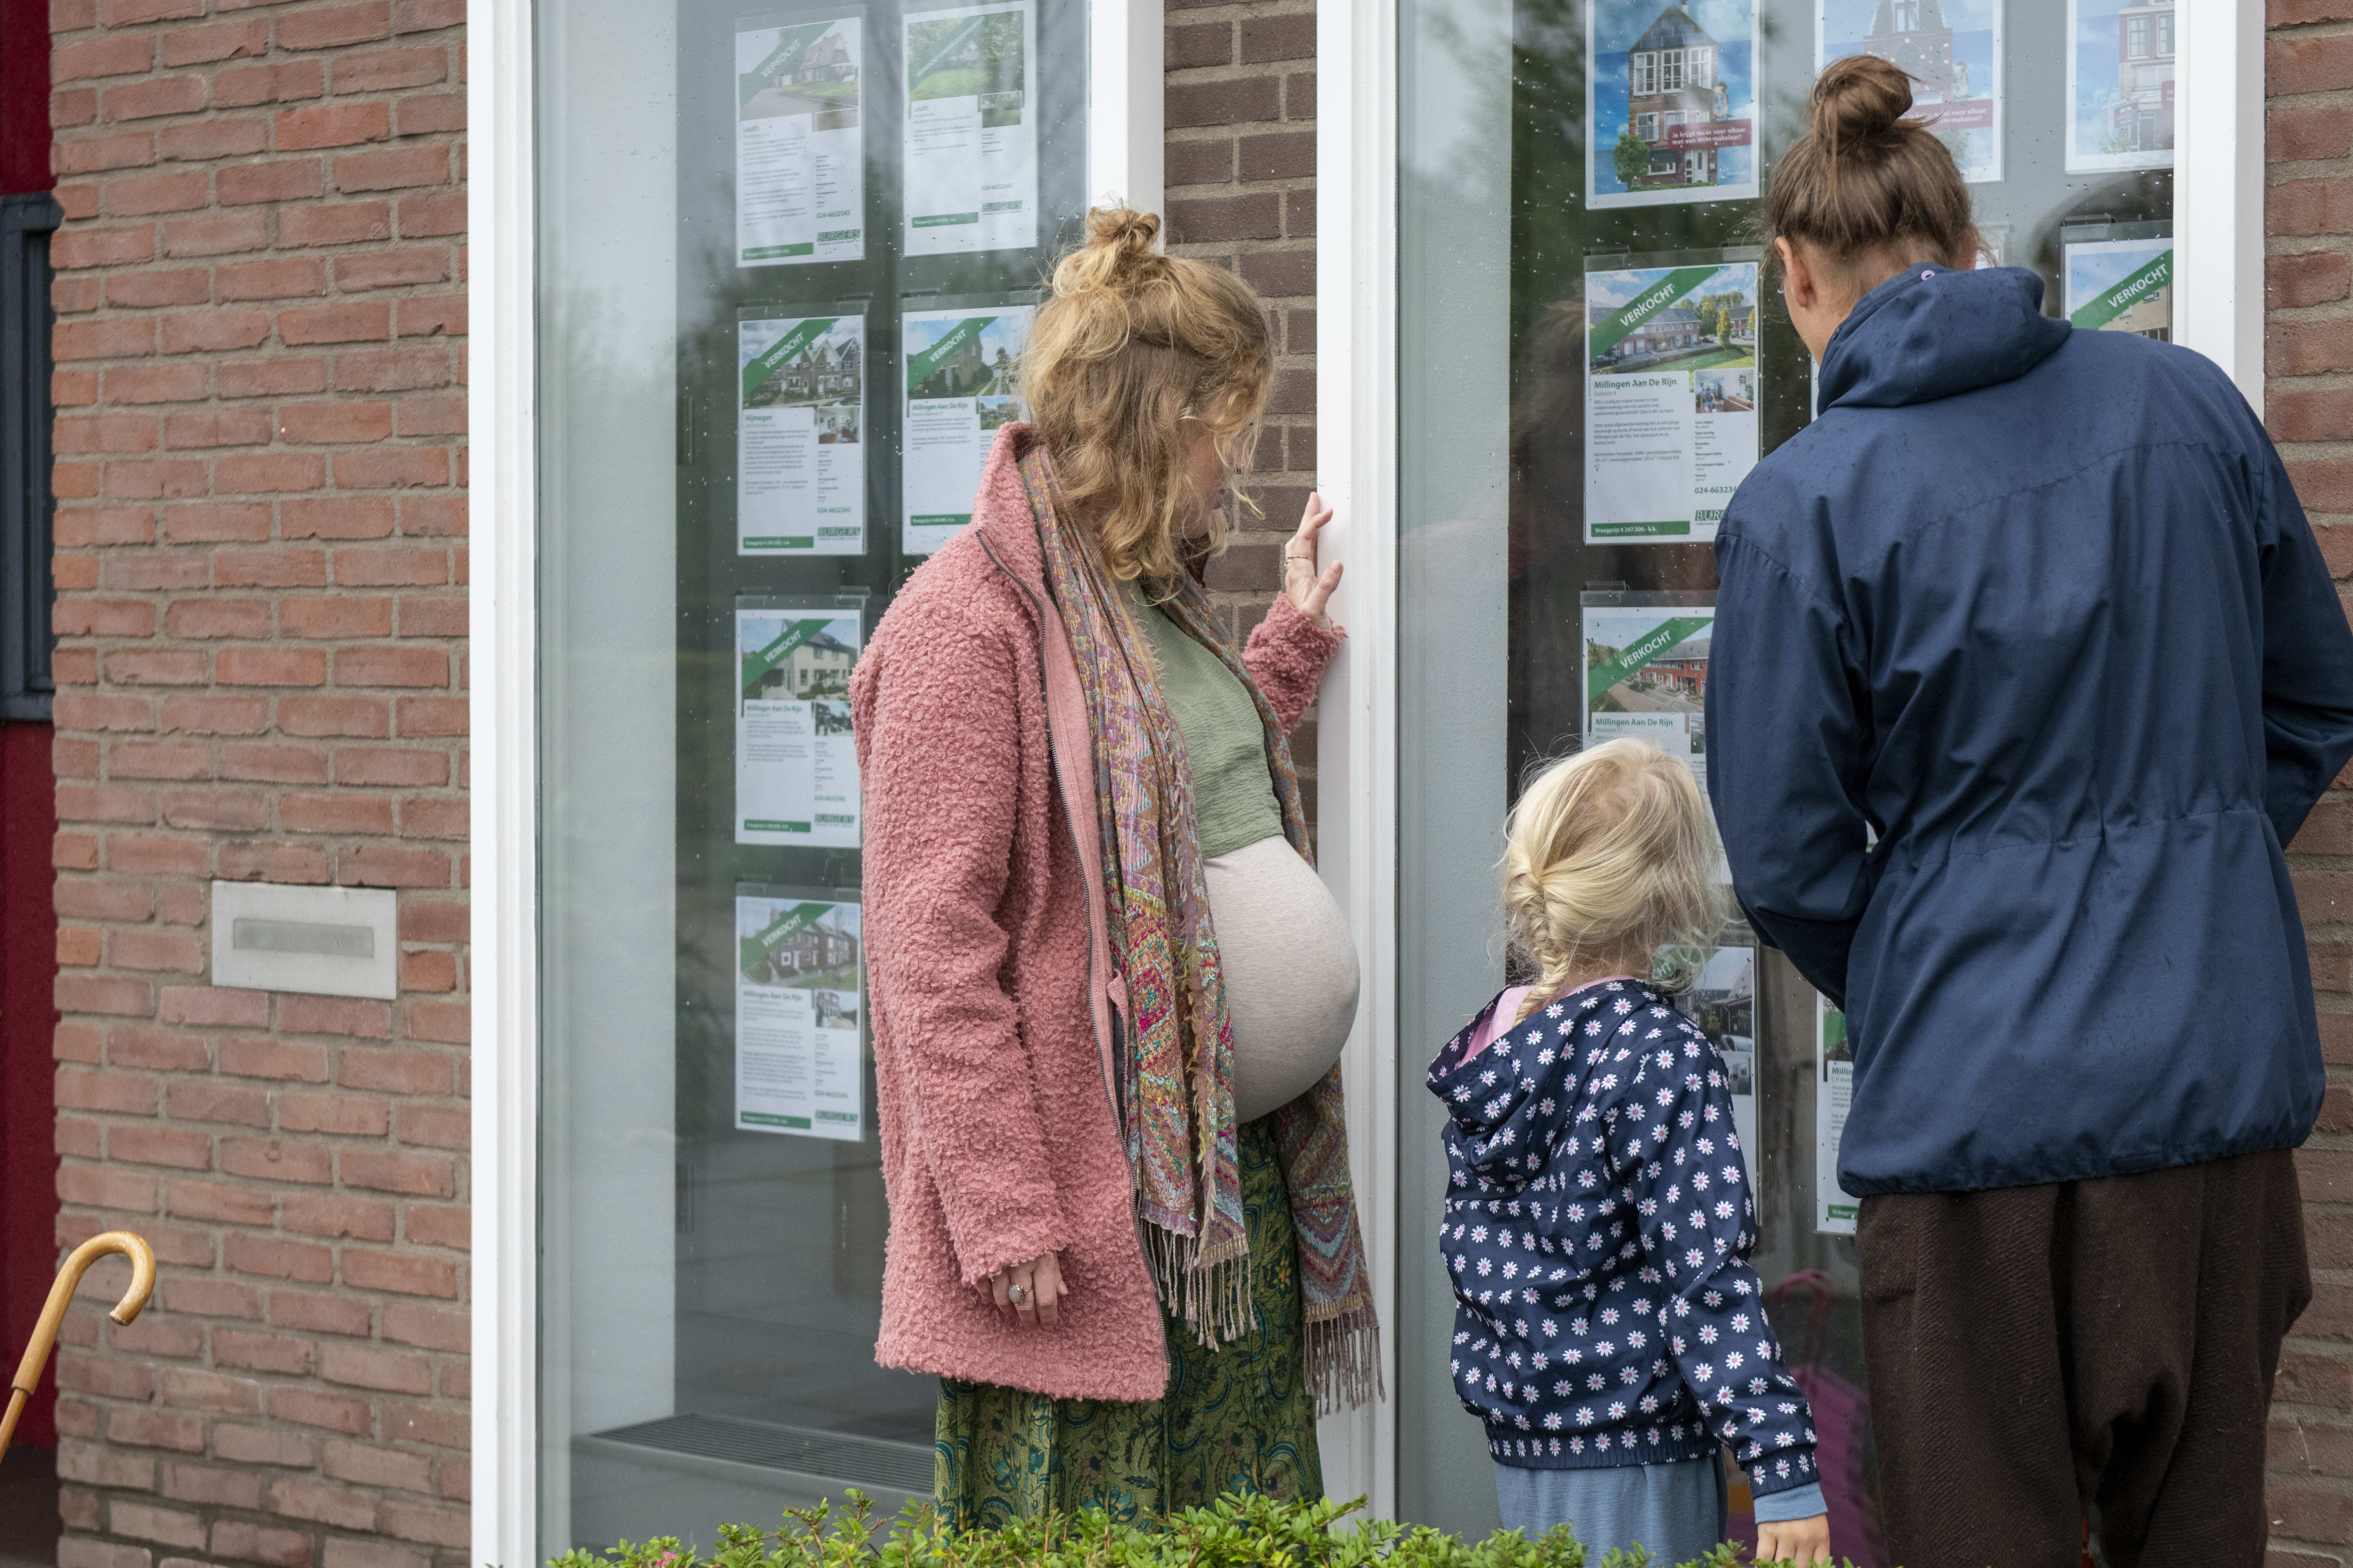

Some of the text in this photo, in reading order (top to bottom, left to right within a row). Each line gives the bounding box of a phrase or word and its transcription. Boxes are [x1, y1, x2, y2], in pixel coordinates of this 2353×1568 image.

[760, 39, 800, 77] VERKOCHT
[817, 229, 860, 242] BURGERS
[2108, 263, 2168, 308] VERKOCHT
[1620, 283, 1674, 327] VERKOCHT
[764, 331, 803, 368] VERKOCHT
[929, 328, 966, 362] VERKOCHT
[1594, 381, 1630, 390] Millingen
[1661, 377, 1677, 387] Rijn
[912, 403, 937, 411] Millingen
[764, 629, 801, 662] VERKOCHT
[1620, 630, 1671, 668] VERKOCHT
[791, 705, 802, 714] Rijn
[1596, 718, 1629, 727] Millingen
[1659, 718, 1673, 727] Rijn
[762, 913, 801, 946] VERKOCHT
